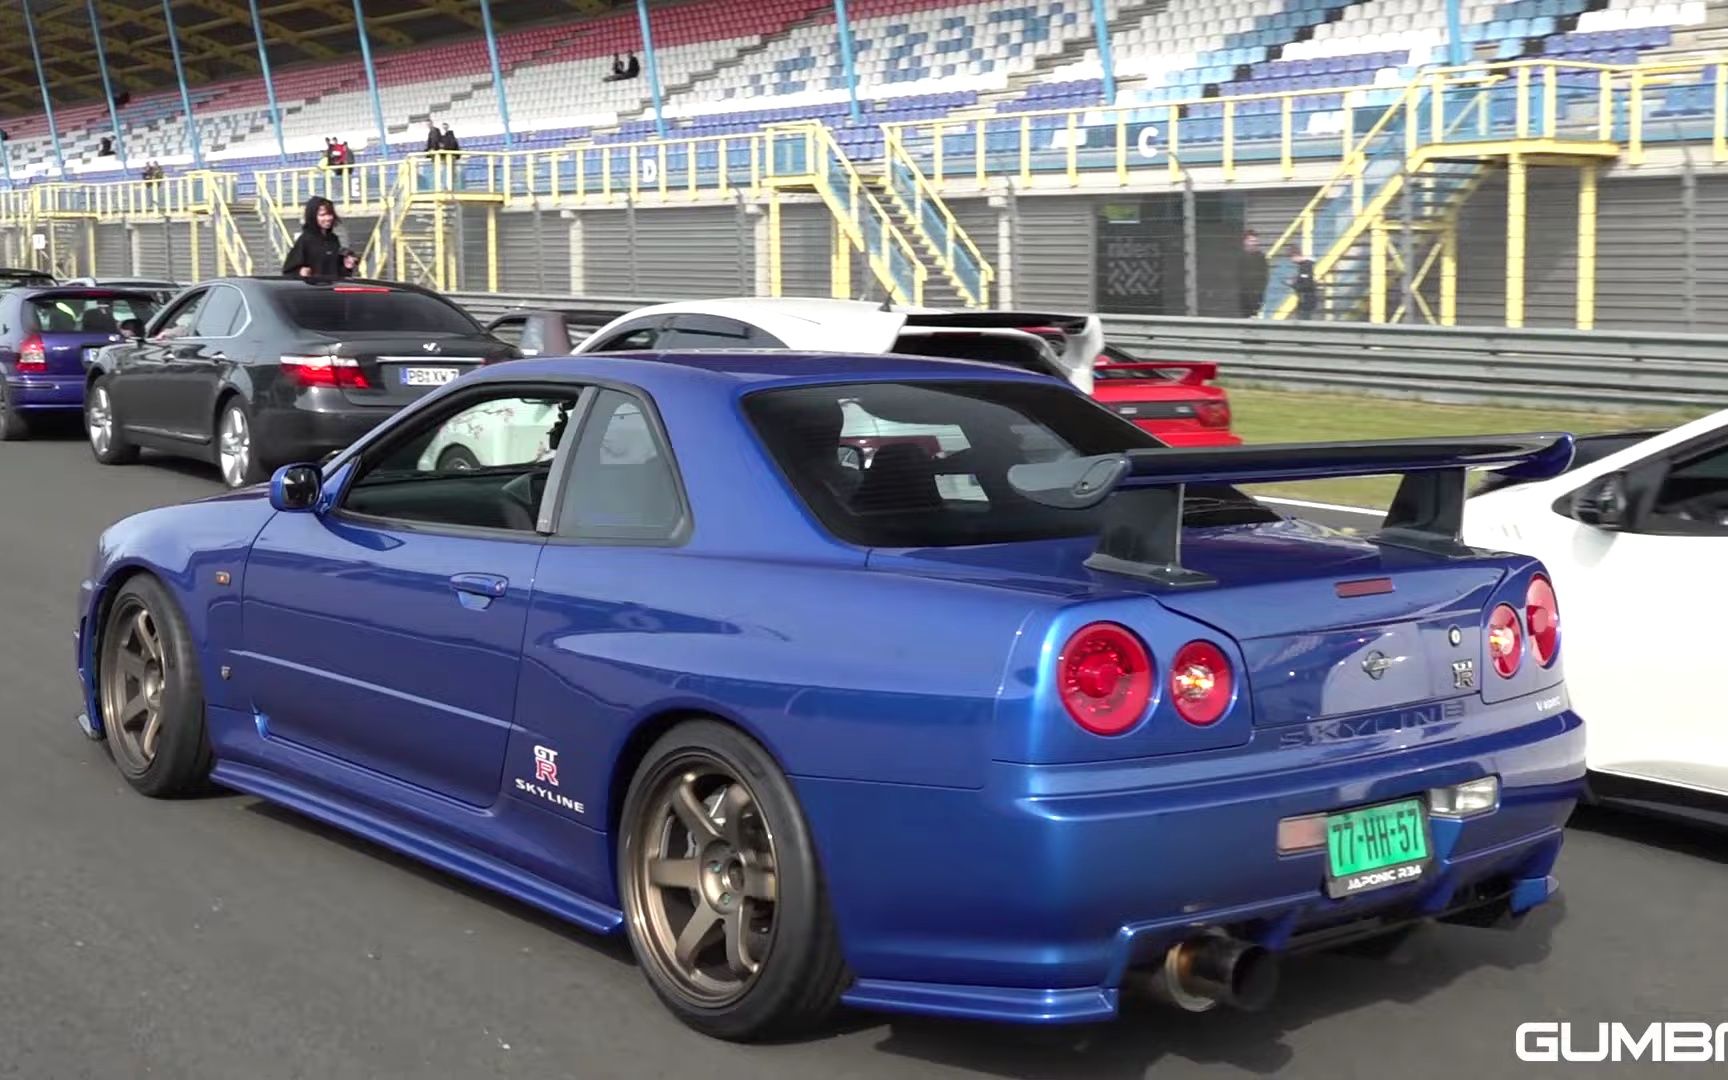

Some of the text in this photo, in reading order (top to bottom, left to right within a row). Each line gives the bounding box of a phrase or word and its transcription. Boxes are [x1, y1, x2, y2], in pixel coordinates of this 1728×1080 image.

[1138, 126, 1159, 158] C
[642, 158, 657, 183] D
[351, 177, 360, 197] E
[1280, 701, 1464, 749] SKYLINE
[534, 744, 558, 762] GT
[535, 756, 559, 787] R
[515, 778, 585, 814] SKYLINE
[1332, 808, 1419, 867] 77-HH-57
[1347, 864, 1422, 890] JAPONIC R34
